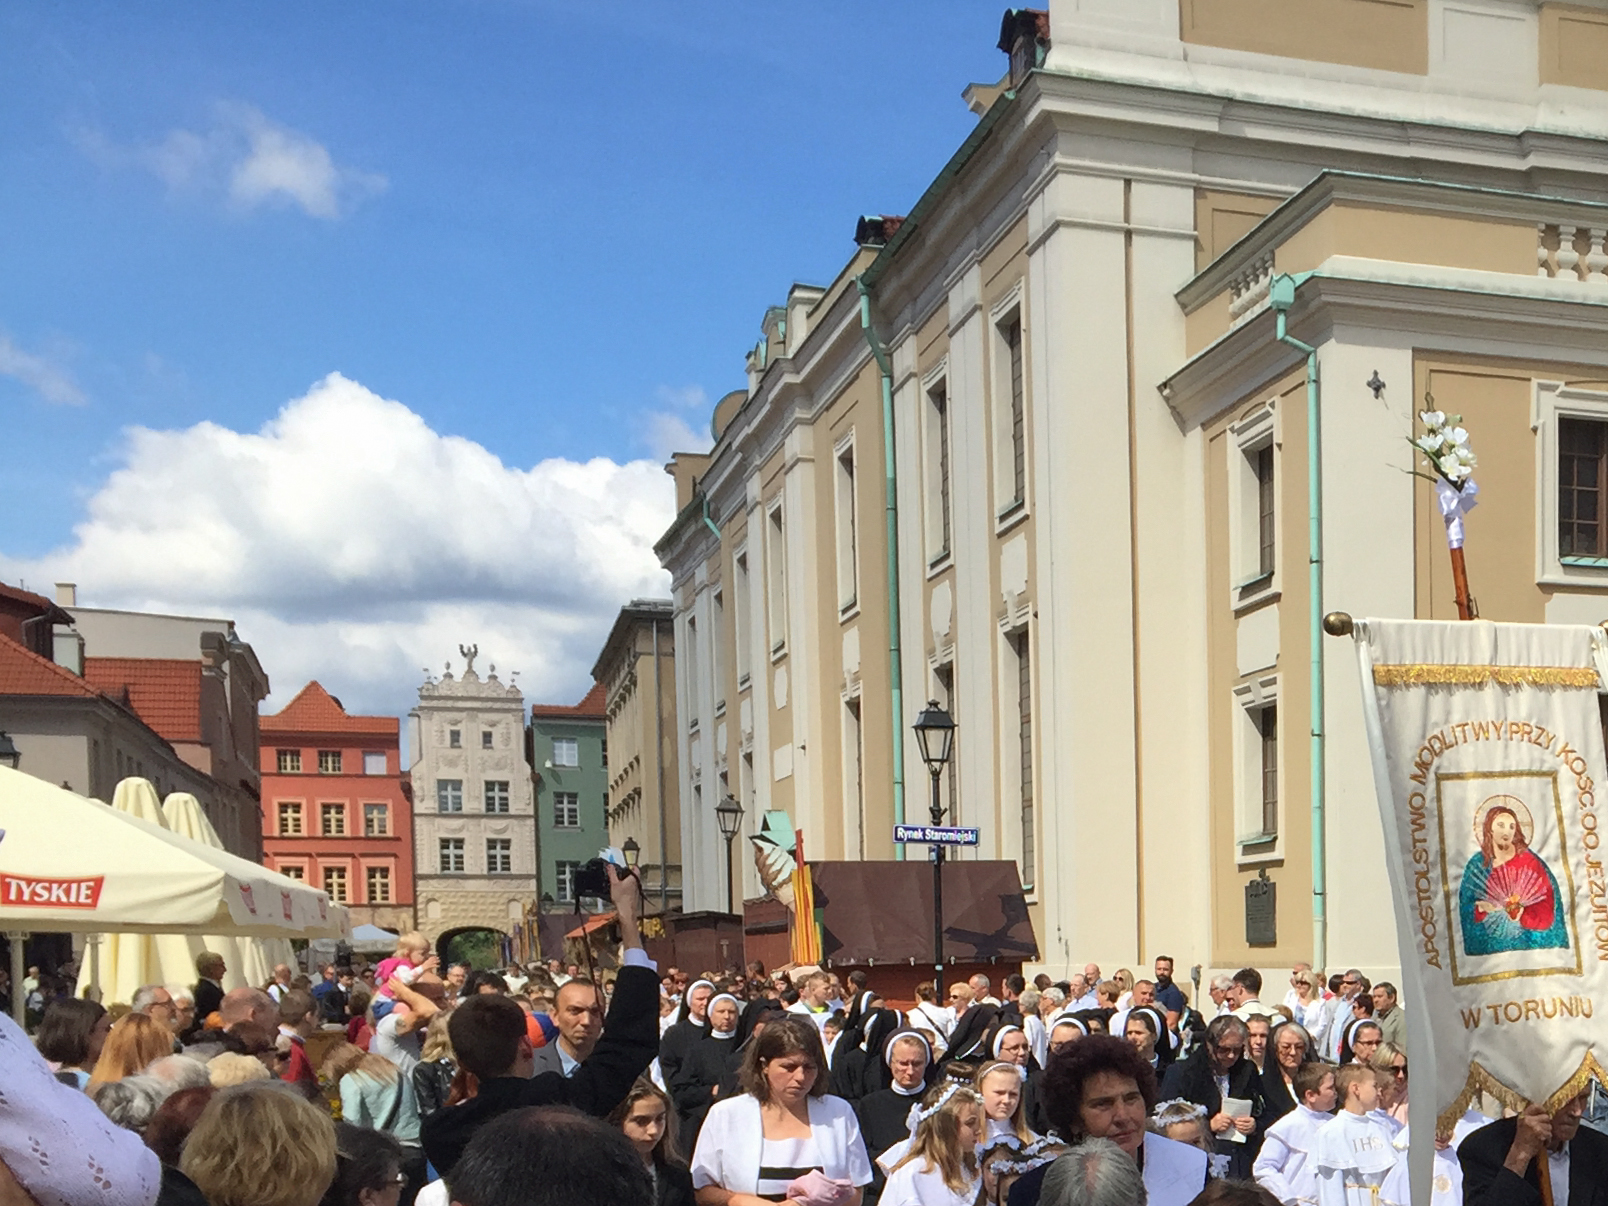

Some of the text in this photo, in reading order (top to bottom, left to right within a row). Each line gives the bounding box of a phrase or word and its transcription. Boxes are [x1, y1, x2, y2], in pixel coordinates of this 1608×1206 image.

[1507, 721, 1557, 750] PRZY
[1409, 720, 1504, 786] MODLITWY
[897, 827, 976, 844] Rynek Staromiejski
[5, 877, 96, 904] TYSKIE
[1407, 791, 1442, 970] APOSTOLSTWO
[1460, 996, 1594, 1030] W TORUNIU
[1352, 1136, 1384, 1154] IHS
